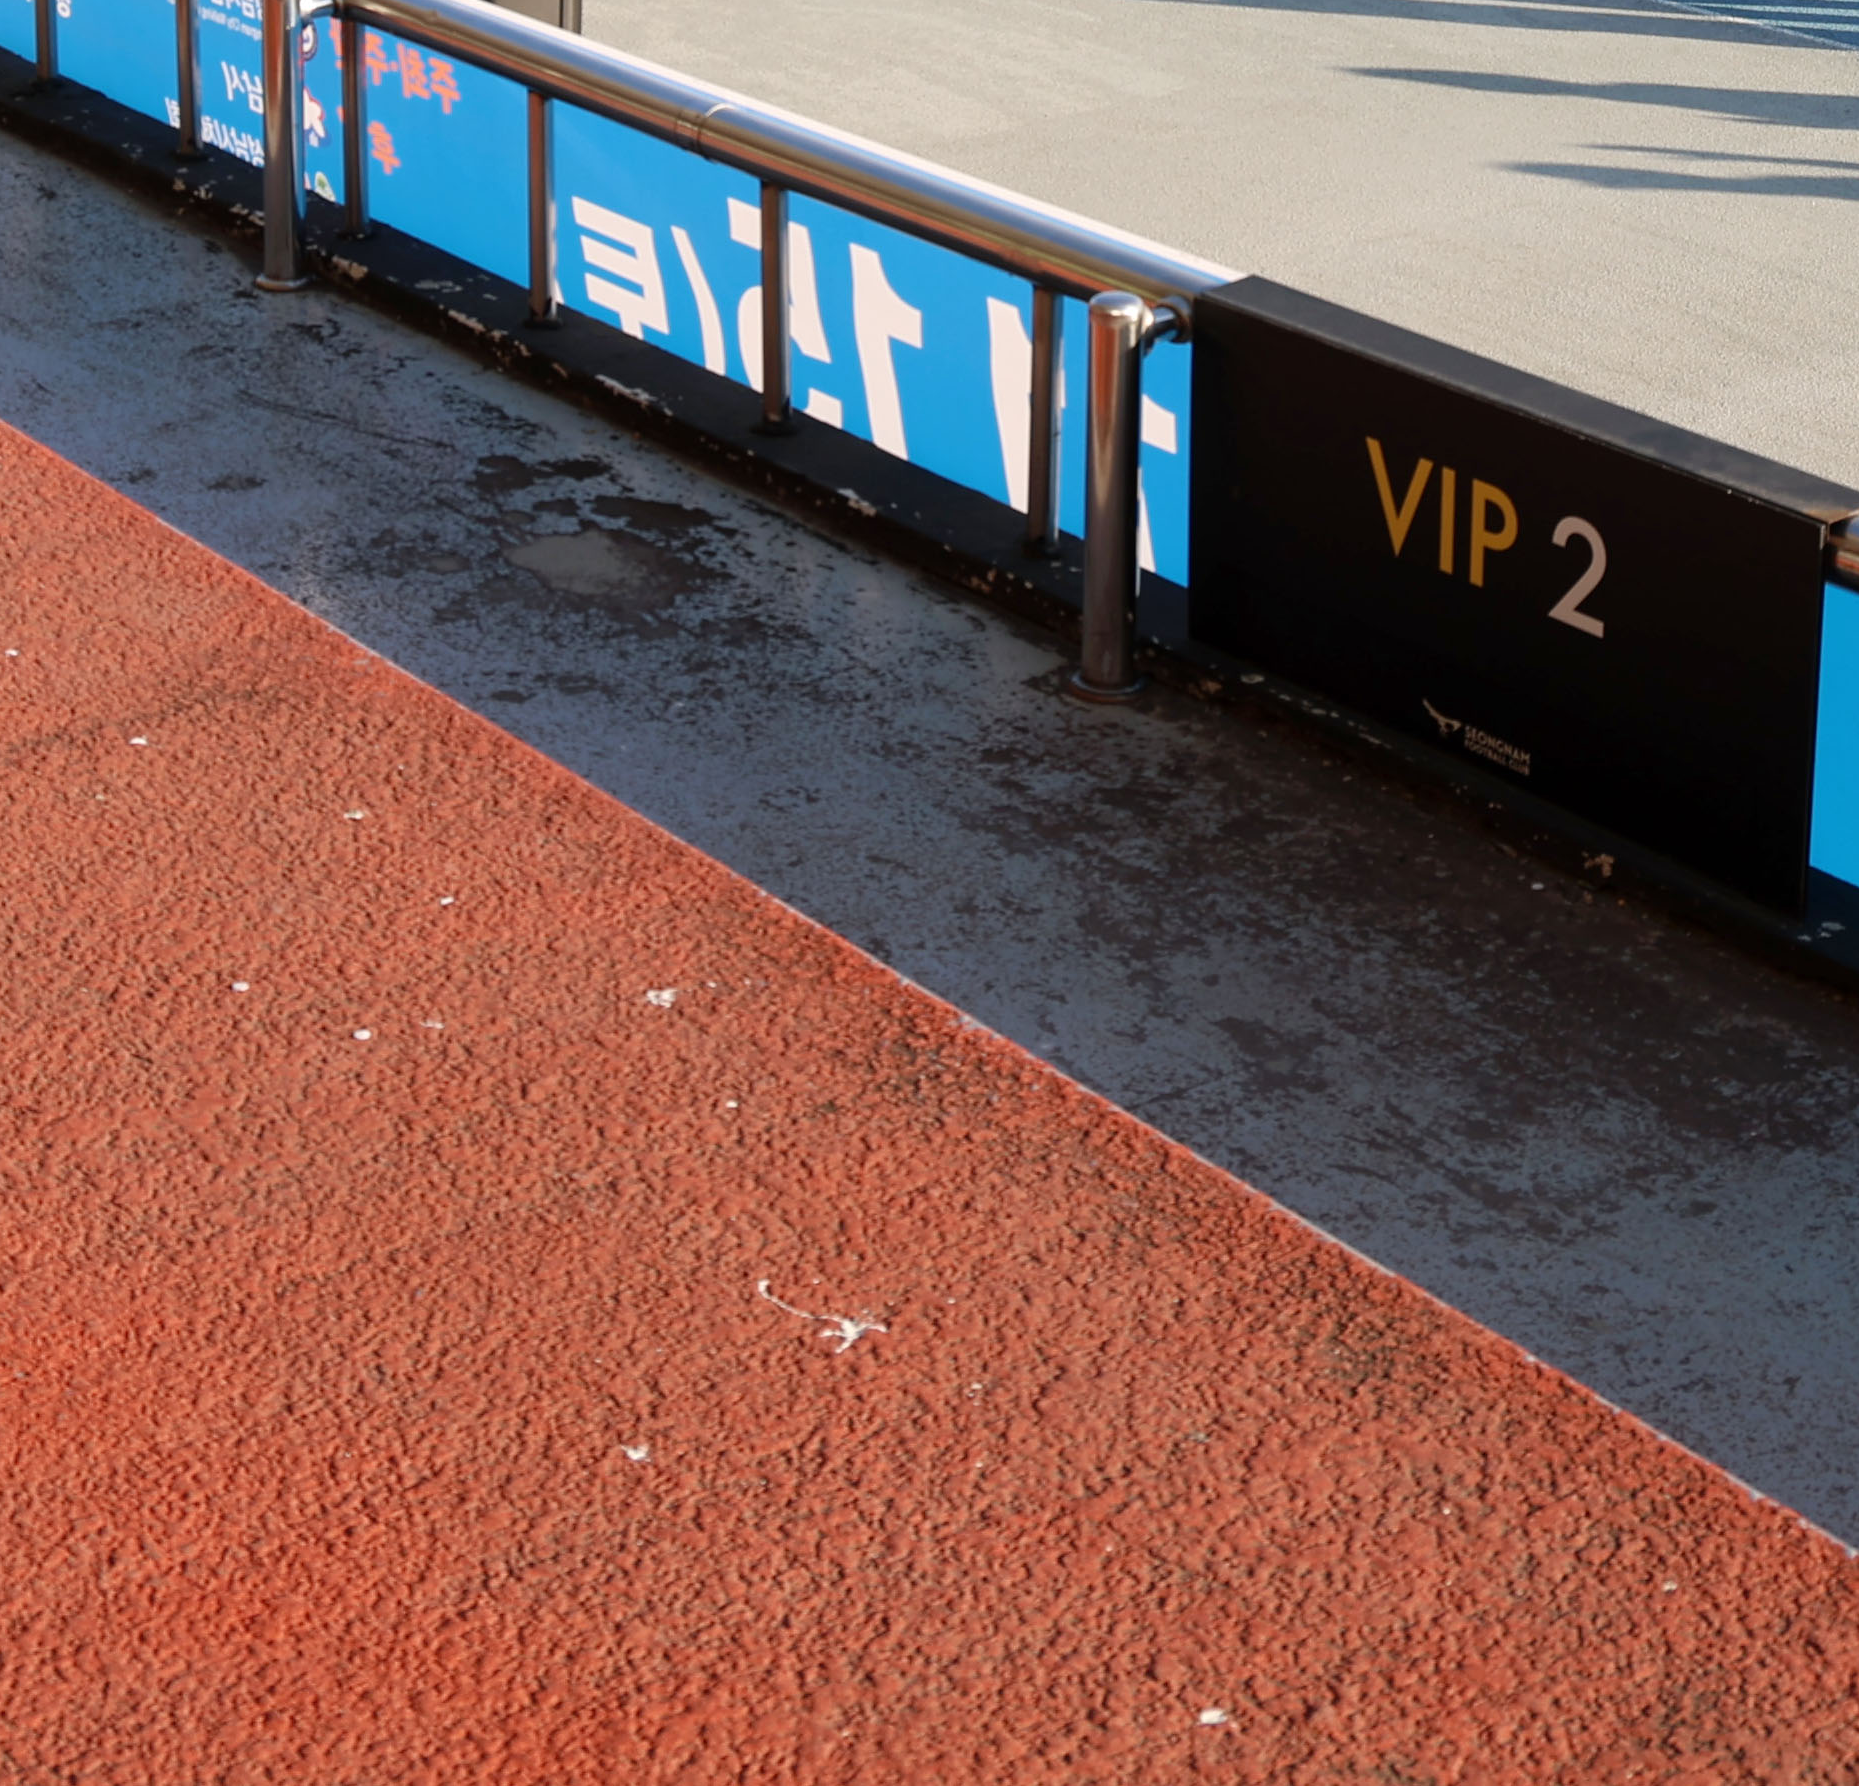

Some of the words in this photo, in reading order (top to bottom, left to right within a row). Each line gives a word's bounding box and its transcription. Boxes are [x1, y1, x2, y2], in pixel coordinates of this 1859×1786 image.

[1366, 436, 1519, 589] VIP
[1547, 516, 1609, 639] 2
[1464, 724, 1531, 766] SEONGNAM
